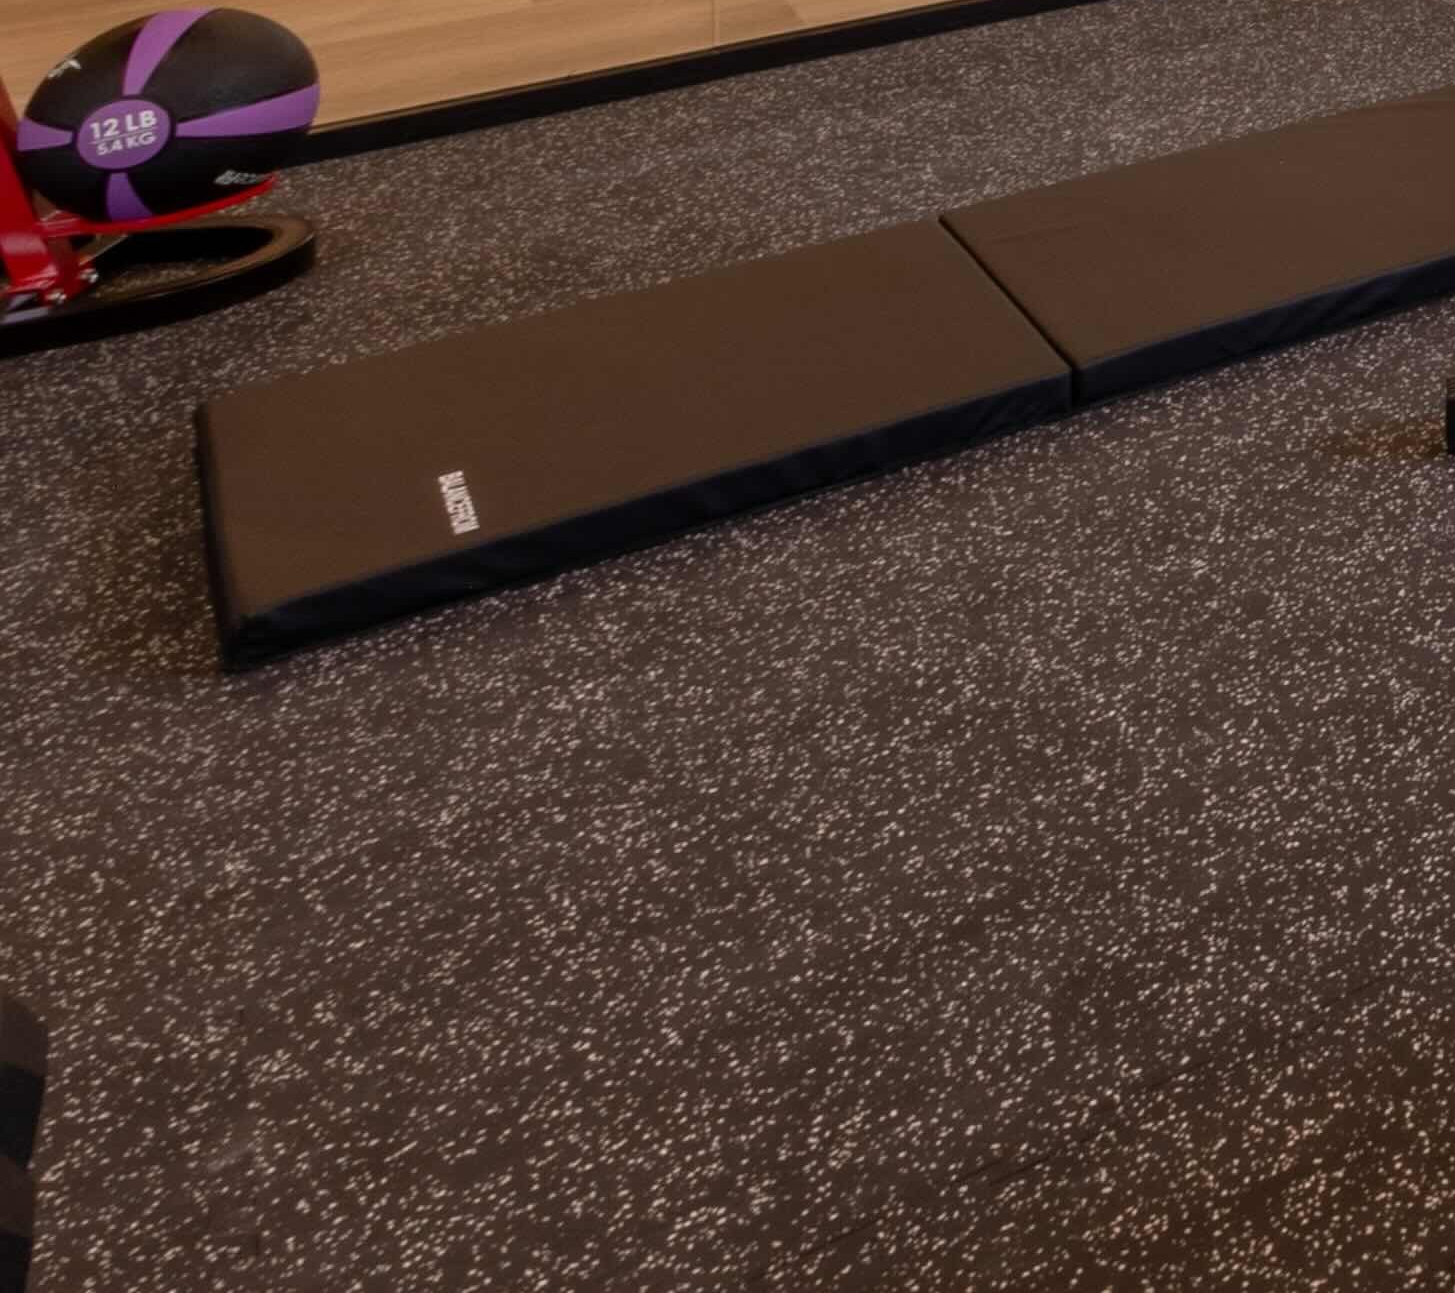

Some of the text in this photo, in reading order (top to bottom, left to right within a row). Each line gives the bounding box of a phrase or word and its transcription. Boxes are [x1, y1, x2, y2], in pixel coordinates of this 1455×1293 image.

[89, 109, 158, 140] 12 LB
[126, 131, 157, 150] KG
